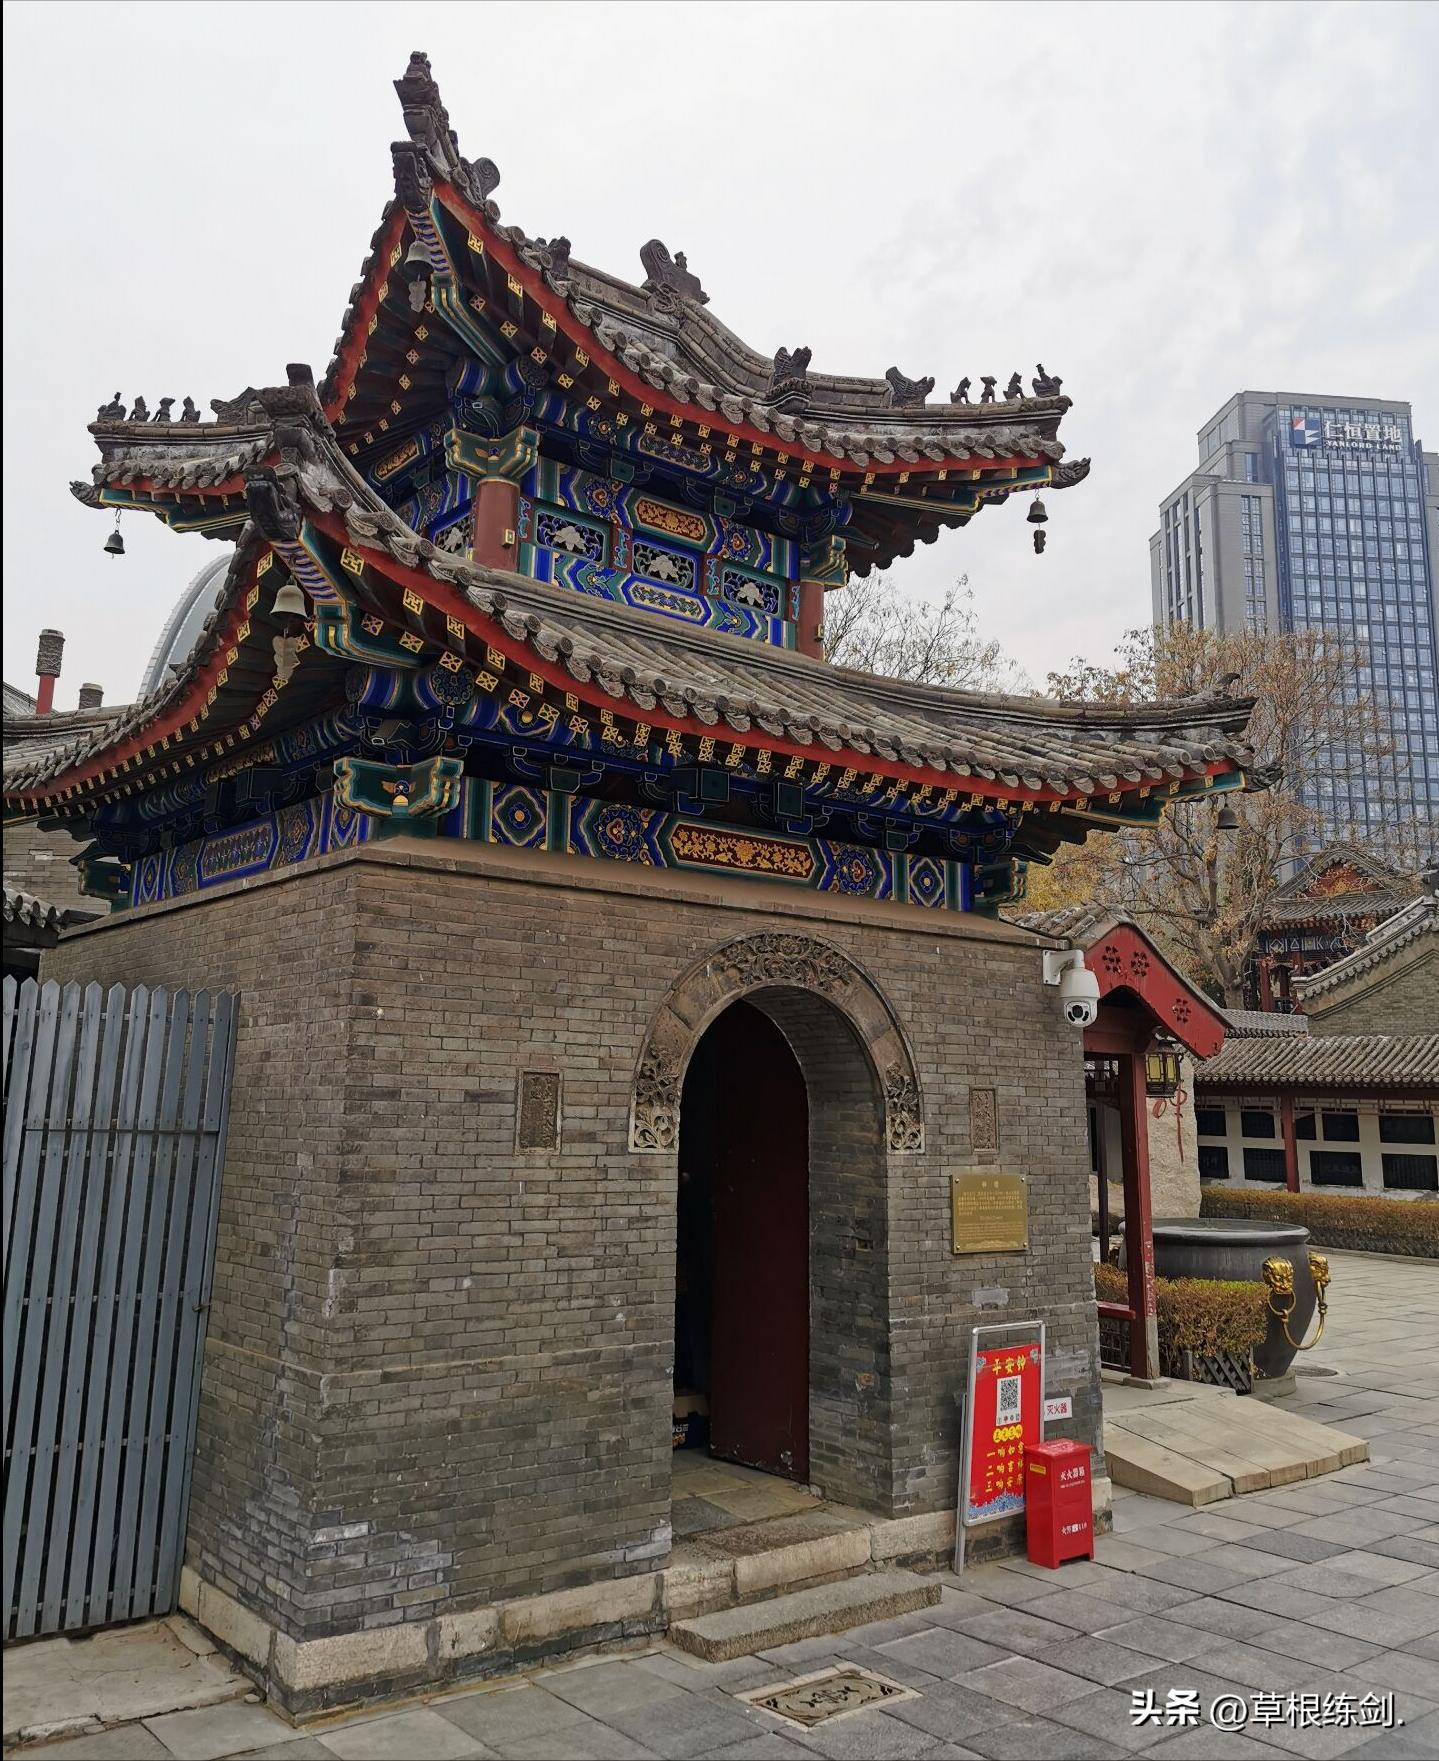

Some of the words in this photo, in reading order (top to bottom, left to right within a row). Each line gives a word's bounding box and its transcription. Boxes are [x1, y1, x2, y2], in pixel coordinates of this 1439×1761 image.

[1323, 420, 1402, 442] 仁恒置地
[1327, 440, 1372, 449] YANLORD
[1377, 443, 1402, 451] LAND
[992, 1355, 1026, 1375] 平安钟
[1047, 1402, 1068, 1415] 灭火器
[1060, 1466, 1085, 1481] 灭火器箱
